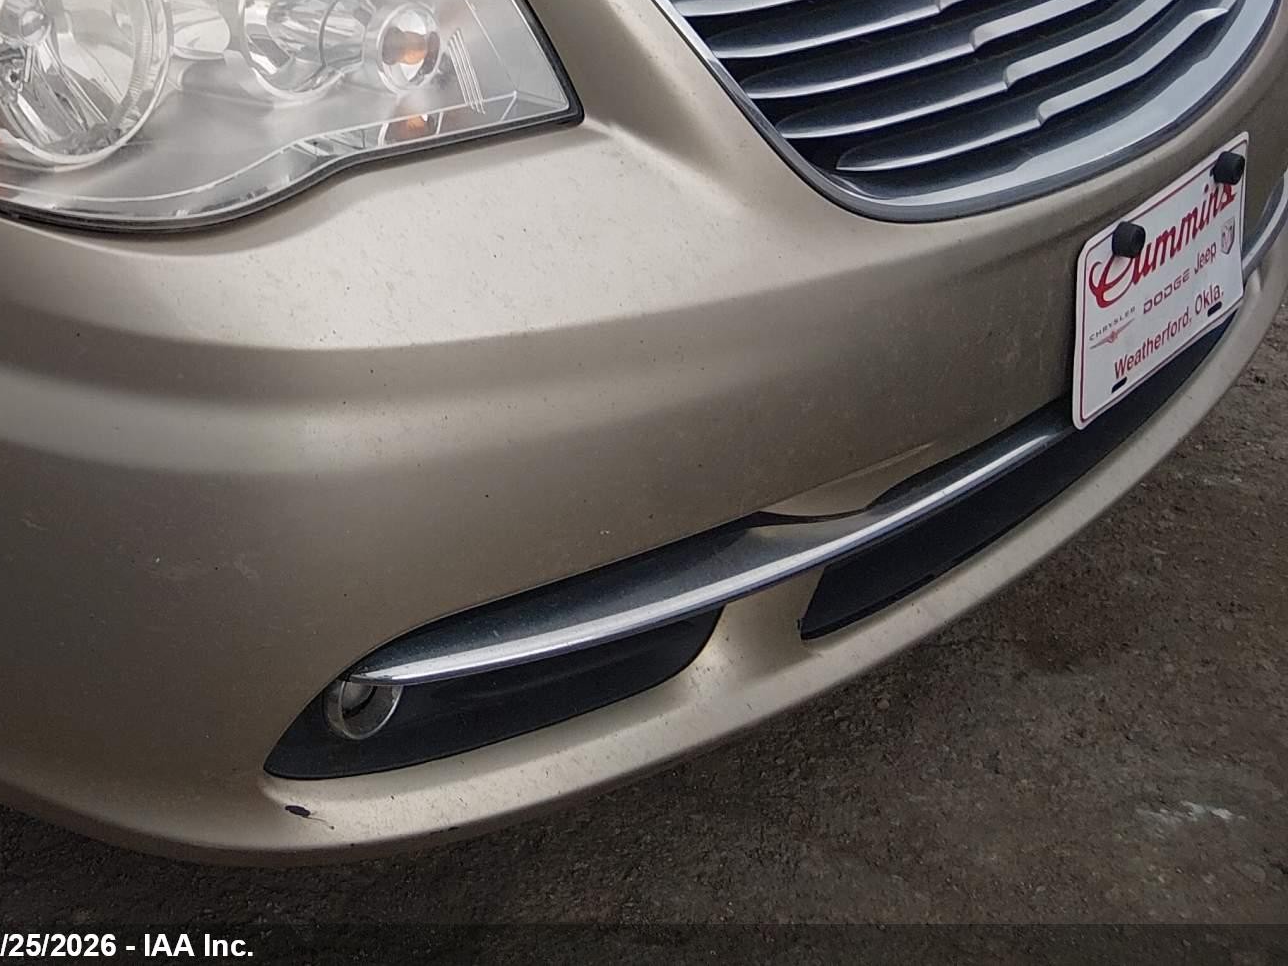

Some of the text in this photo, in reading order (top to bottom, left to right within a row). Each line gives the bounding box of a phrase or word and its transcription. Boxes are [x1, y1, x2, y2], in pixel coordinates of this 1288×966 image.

[1089, 242, 1217, 341] CHRYSLER DODGE Jeep
[1195, 284, 1224, 316] Okla.
